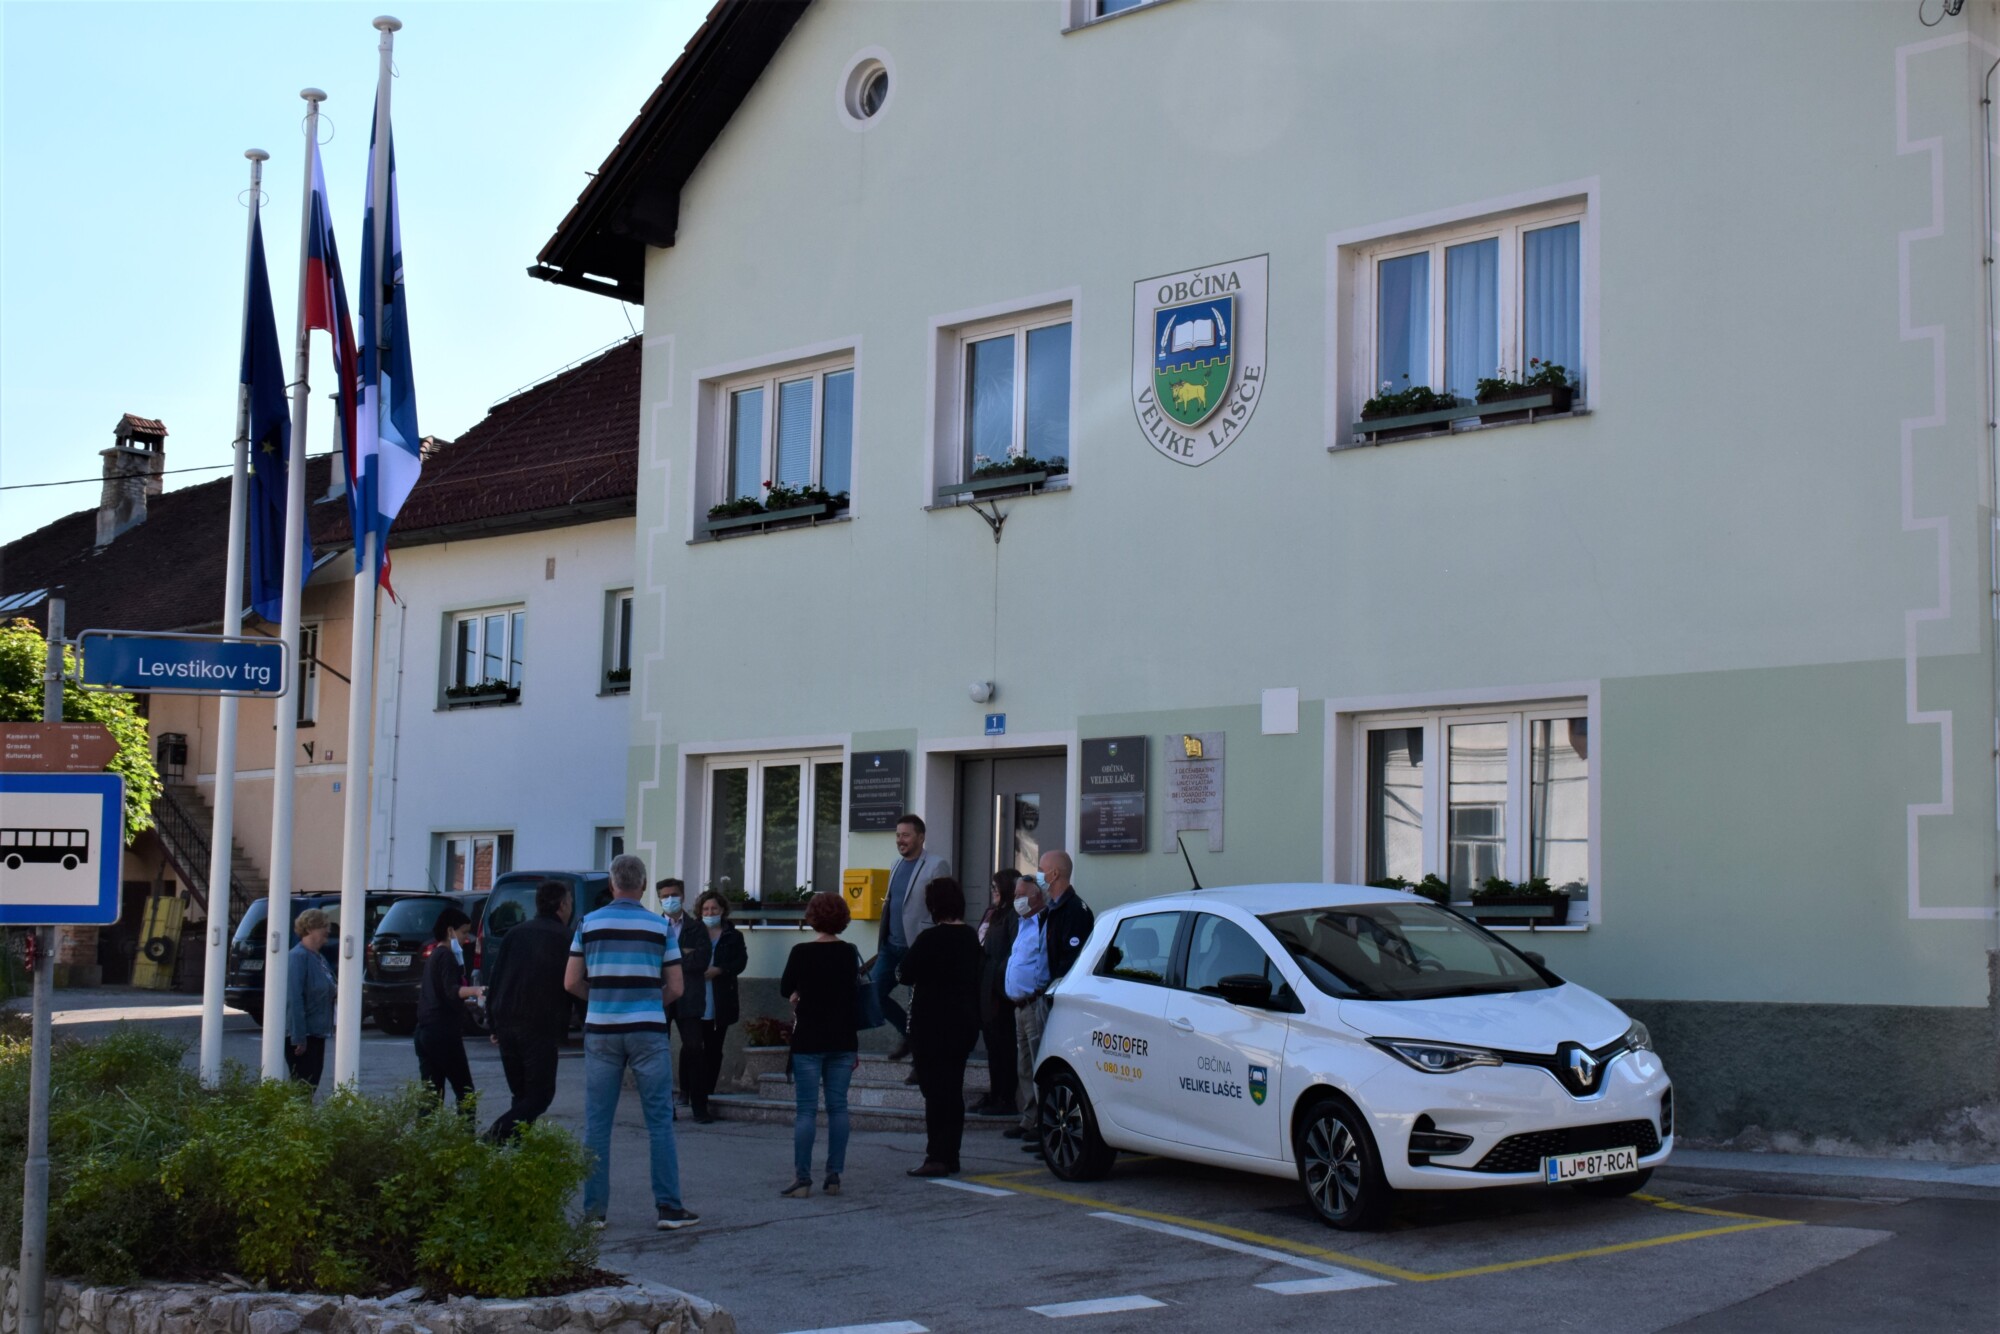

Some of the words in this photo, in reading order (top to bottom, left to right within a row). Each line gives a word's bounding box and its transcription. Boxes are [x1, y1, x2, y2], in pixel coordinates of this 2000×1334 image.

[1157, 271, 1242, 304] OBČINA
[1138, 385, 1196, 458] VELIKE
[1207, 365, 1261, 449] LAŠČE
[138, 656, 237, 680] Levstikov
[244, 662, 271, 685] trg
[992, 716, 997, 728] 1
[5, 752, 31, 760] Kulturna
[1090, 775, 1114, 785] VELIKE
[1115, 772, 1135, 784] LAŠČE
[1102, 764, 1124, 773] OBČINA
[1092, 1030, 1148, 1056] PROSTOFER
[1103, 1061, 1119, 1074] 080
[1120, 1064, 1130, 1077] 10
[1132, 1066, 1143, 1079] 10
[1197, 1056, 1232, 1075] OBČINA
[1179, 1076, 1211, 1094] VELIKE
[1212, 1081, 1243, 1099] LAŠČE
[1560, 1159, 1577, 1178] LJ
[1587, 1152, 1634, 1174] 87-RCA
